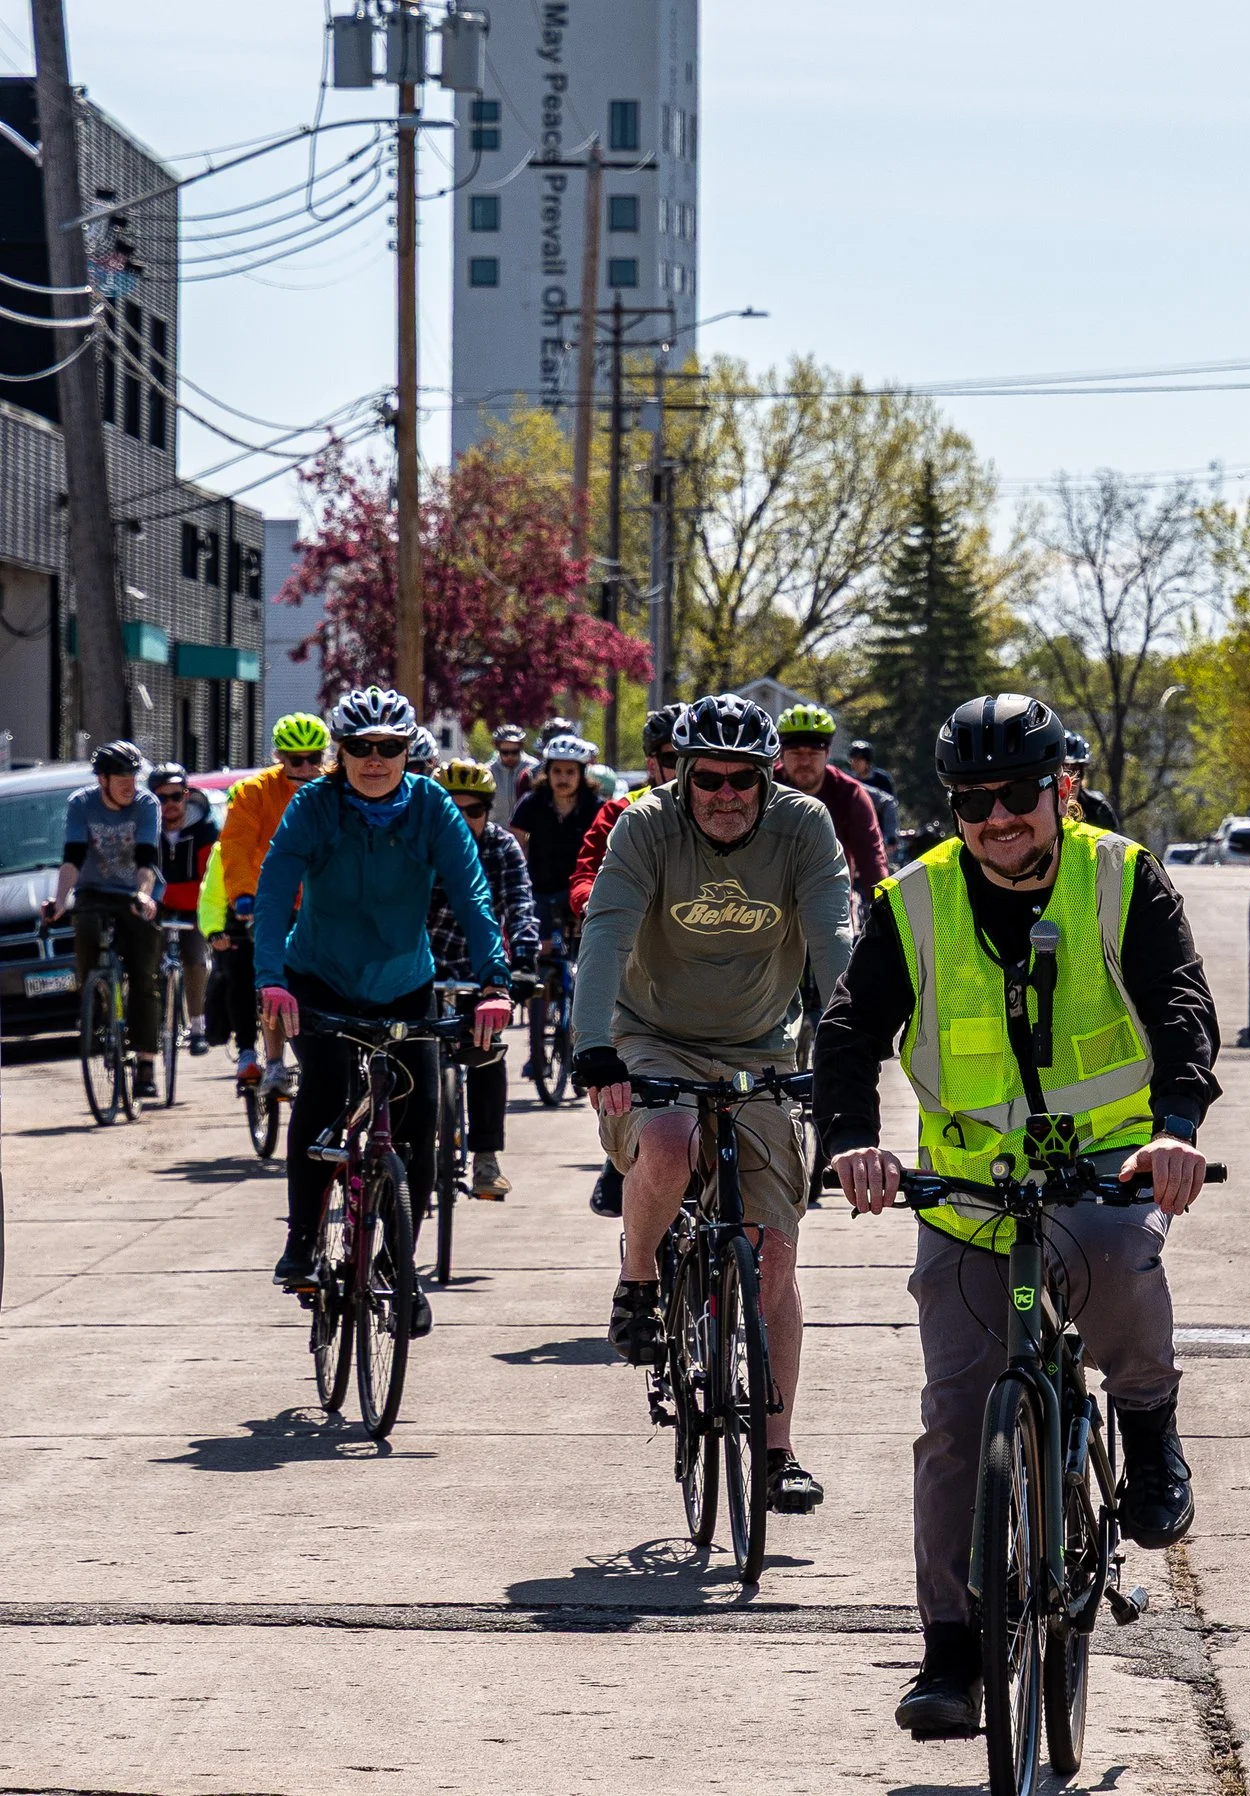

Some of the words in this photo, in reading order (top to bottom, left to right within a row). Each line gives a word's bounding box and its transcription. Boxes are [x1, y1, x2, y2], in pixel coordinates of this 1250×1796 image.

[536, 3, 569, 63] May
[541, 72, 569, 164] Peace
[541, 172, 568, 277] Prevail
[683, 902, 769, 932] Berkley
